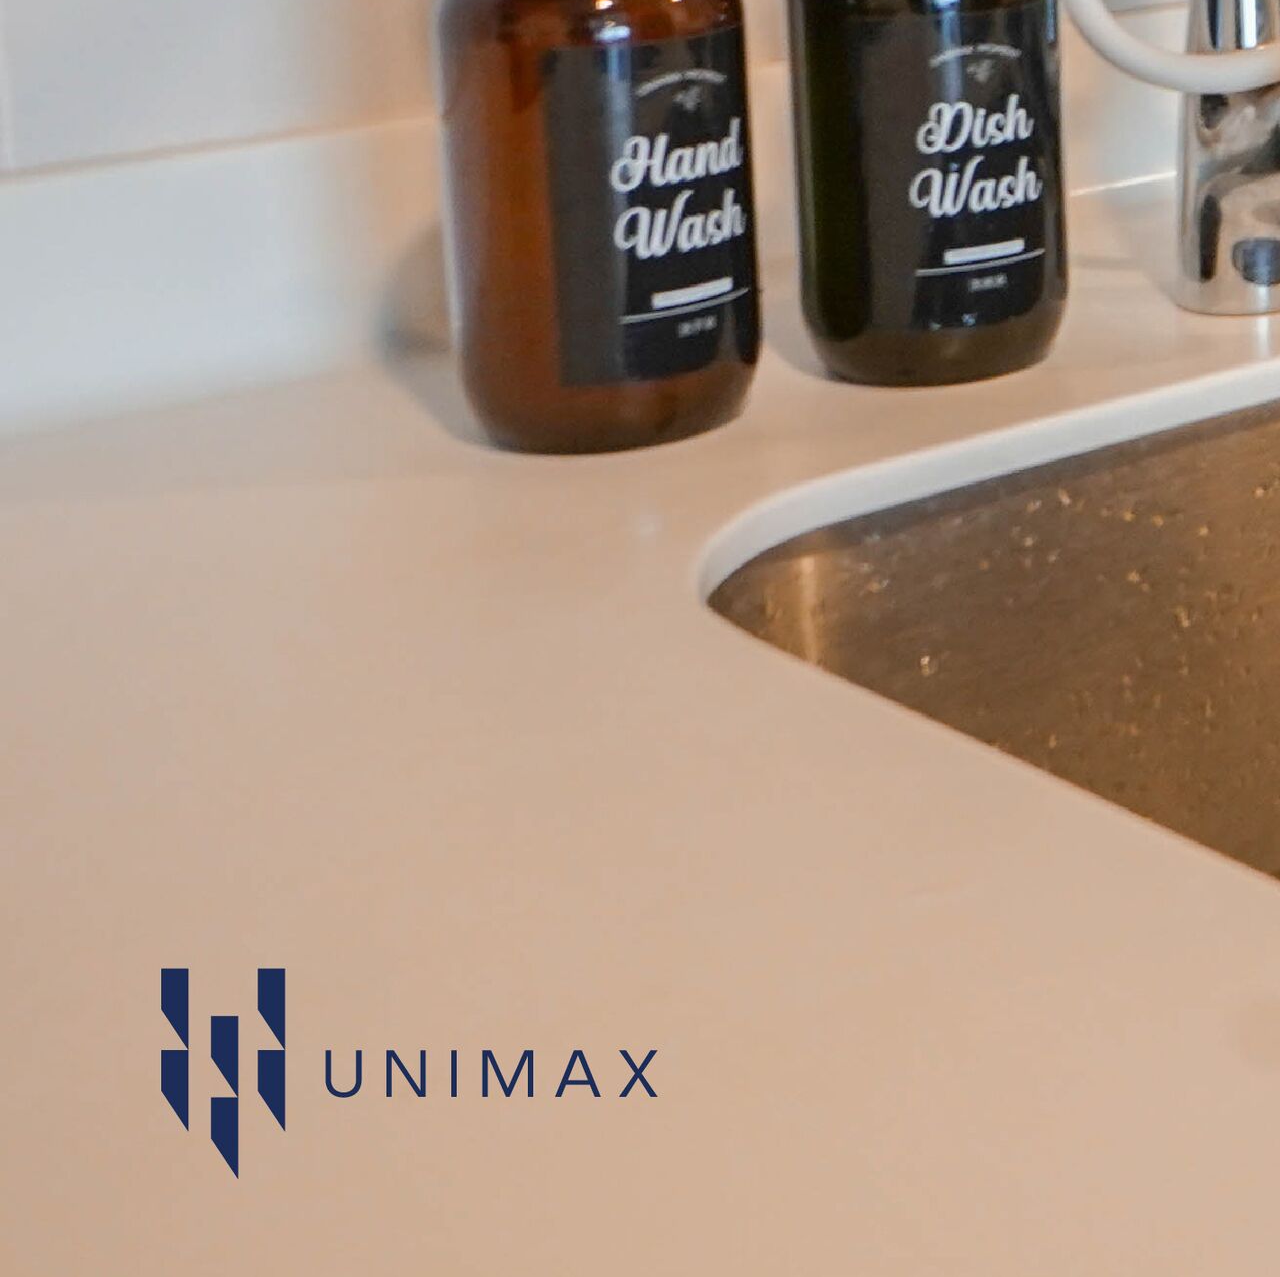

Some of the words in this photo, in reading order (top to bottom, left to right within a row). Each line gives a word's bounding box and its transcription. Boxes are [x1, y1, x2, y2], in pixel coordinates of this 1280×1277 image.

[611, 118, 742, 193] Hand
[916, 94, 1034, 154] Dish
[909, 156, 1042, 218] Wash
[613, 188, 746, 259] Wash
